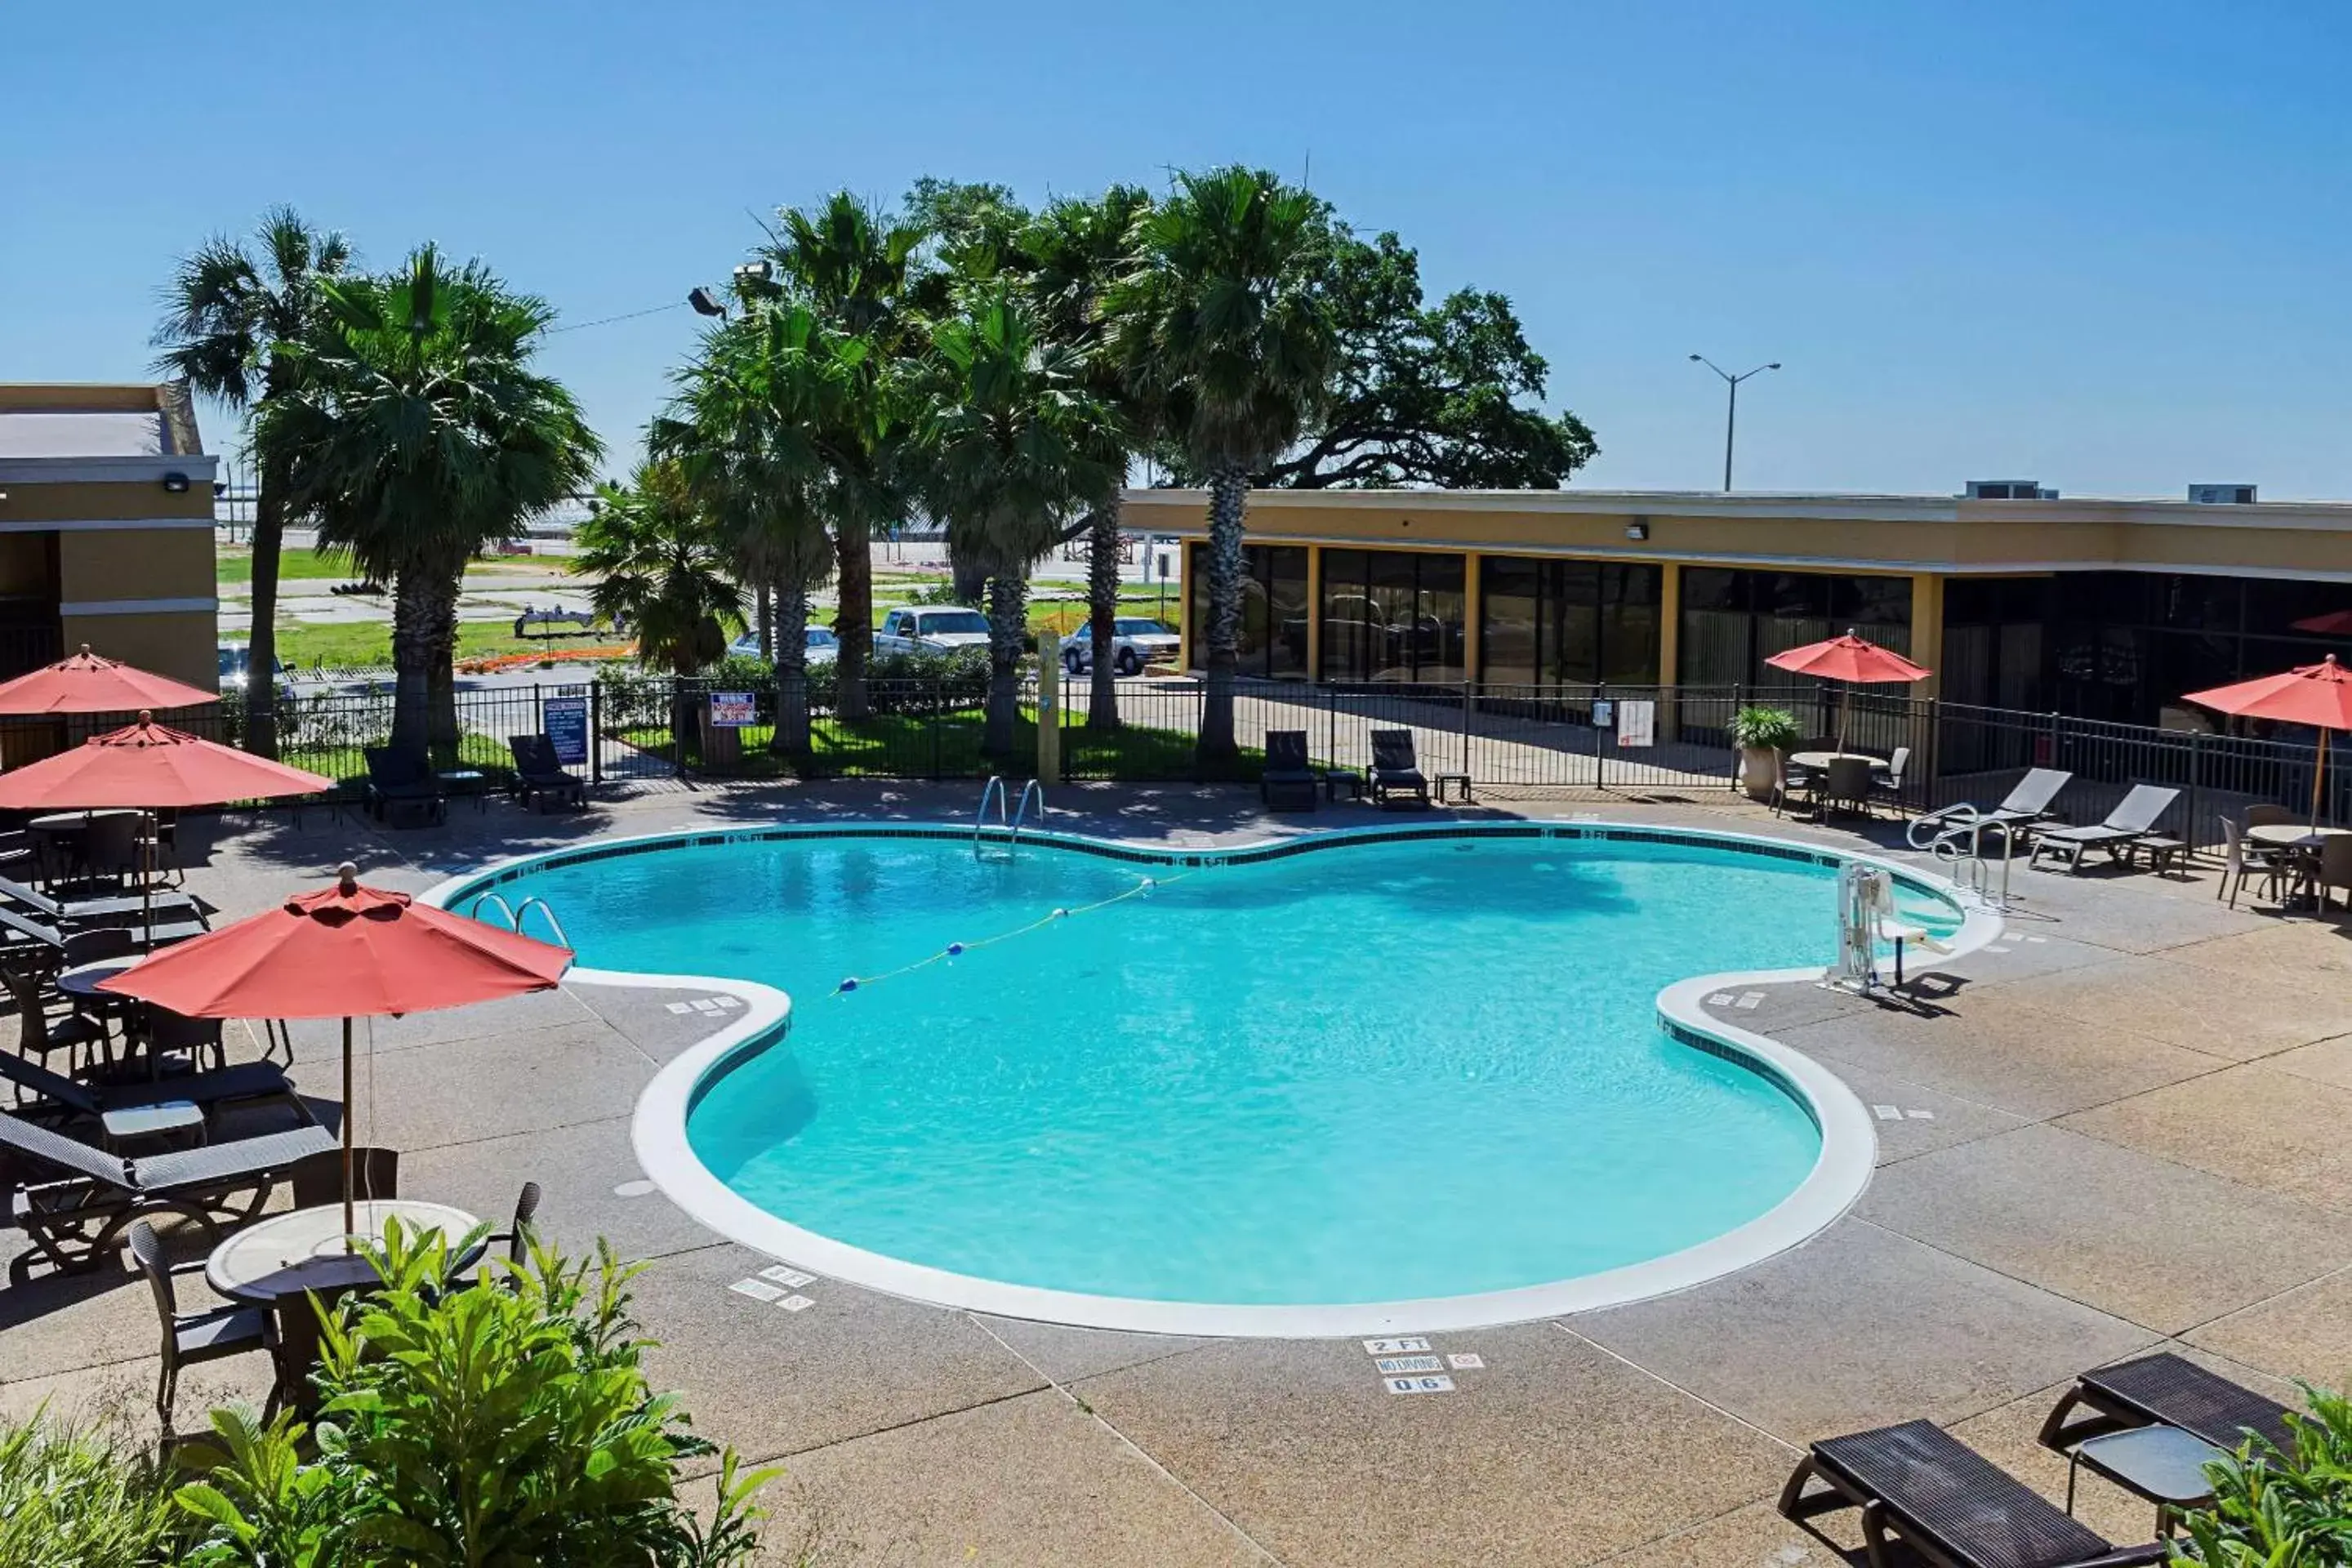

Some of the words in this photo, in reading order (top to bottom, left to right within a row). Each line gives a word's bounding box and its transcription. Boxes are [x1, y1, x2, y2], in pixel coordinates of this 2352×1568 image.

[1374, 1342, 1387, 1352] 2
[1399, 1339, 1426, 1350] FT
[1378, 1359, 1396, 1371] NO
[1396, 1356, 1441, 1370] DIVING
